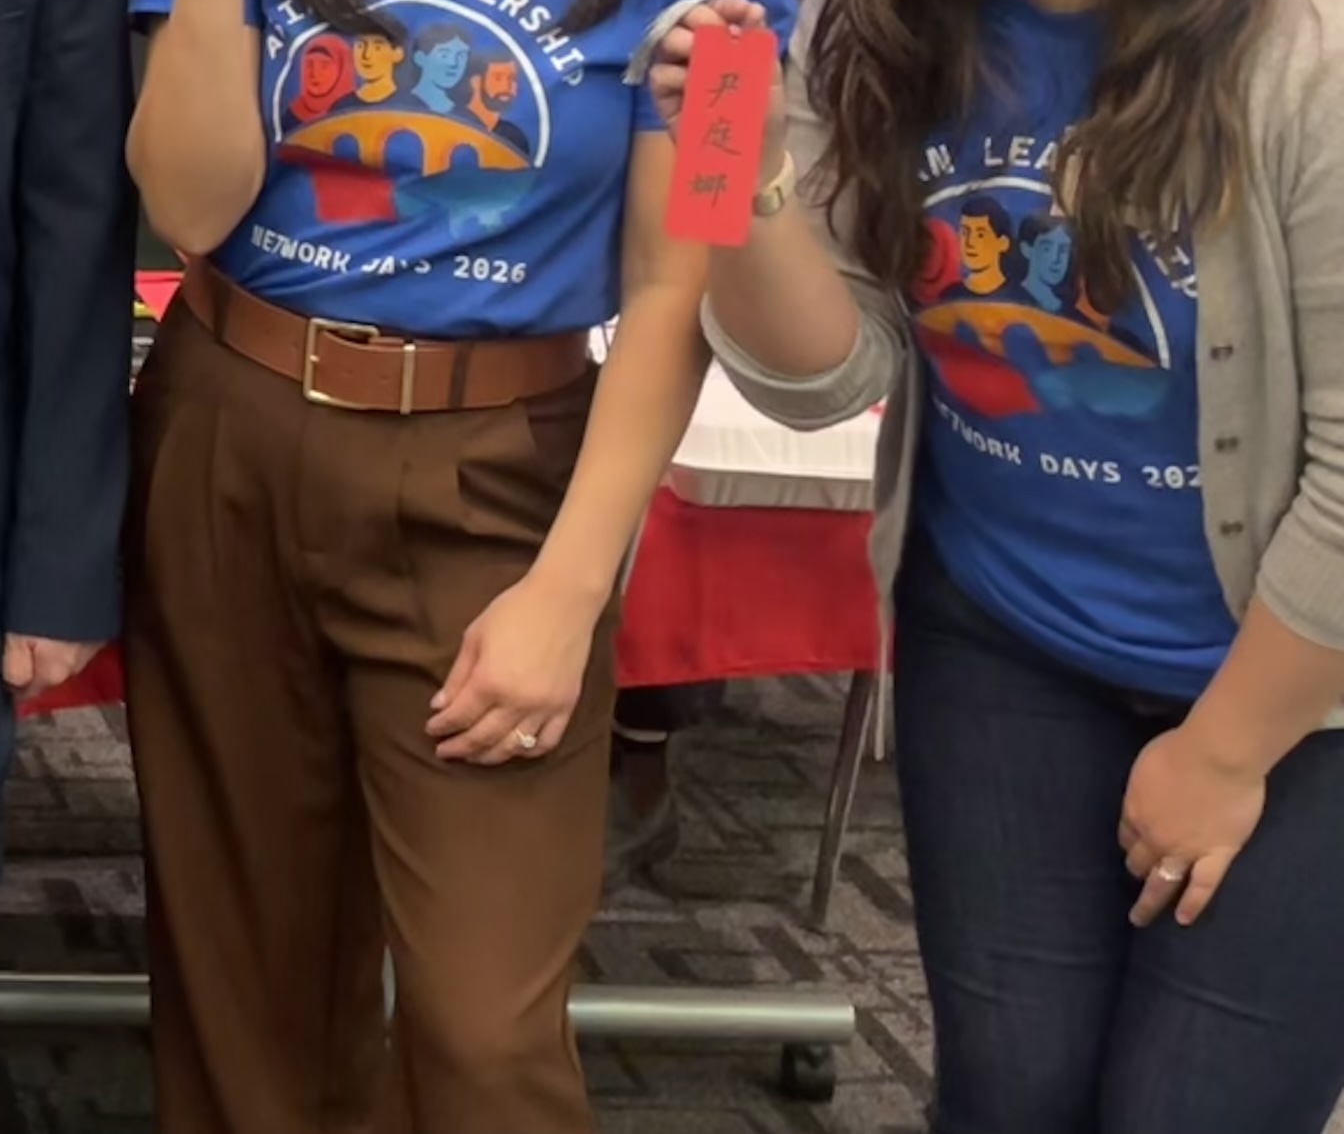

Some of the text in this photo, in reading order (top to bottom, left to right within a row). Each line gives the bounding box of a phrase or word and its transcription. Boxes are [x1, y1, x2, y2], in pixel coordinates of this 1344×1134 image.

[250, 224, 351, 274] NETWORK
[453, 255, 528, 284] 2026
[936, 398, 1200, 490] ETWORK DAYS 202
